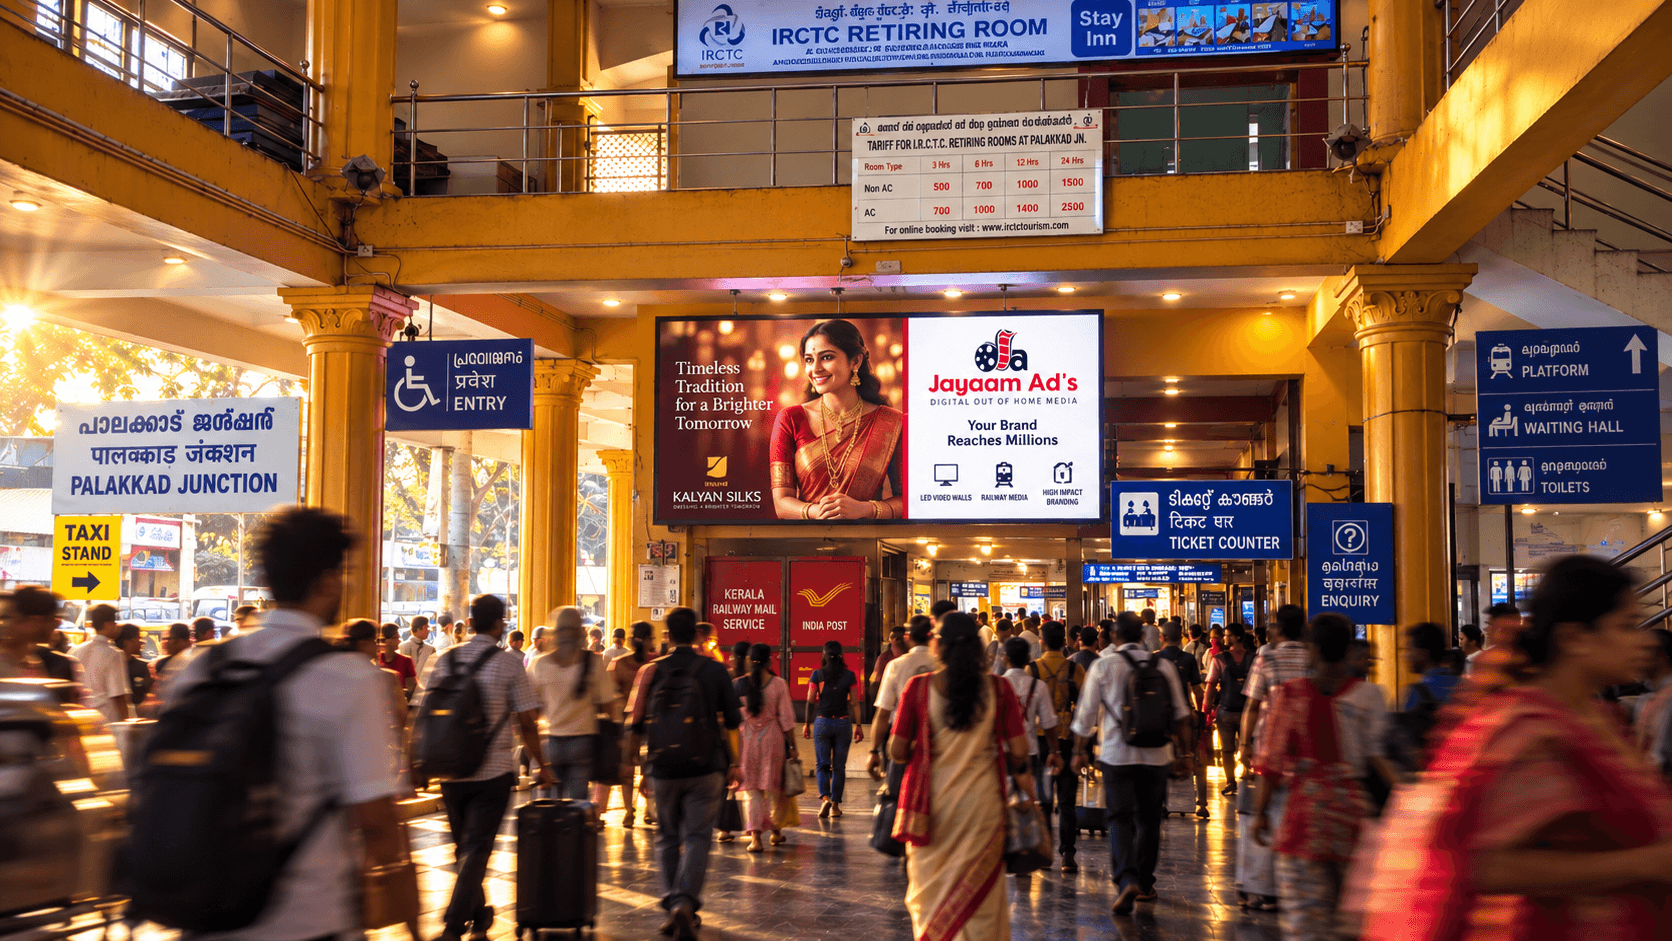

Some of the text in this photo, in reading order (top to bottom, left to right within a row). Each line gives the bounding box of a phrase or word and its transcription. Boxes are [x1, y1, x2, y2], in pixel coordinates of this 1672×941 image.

[1080, 11, 1124, 29] Stay
[773, 18, 1048, 46] IRCTC RETIRING ROOM
[1086, 31, 1117, 47] Inn
[701, 49, 743, 61] IRCTC
[867, 132, 1088, 151] TARIFF FOR I.R.C.T.C. RETIRING ROOMS AT PALAKKAD JN.
[932, 160, 951, 169] 3 Hrs
[974, 159, 994, 168] 6 Hrs
[1016, 158, 1039, 167] 12 Hrs
[1061, 156, 1084, 165] 24 Hrs
[864, 162, 903, 172] Room Type
[933, 182, 950, 191] 500
[976, 181, 993, 190] 700
[1017, 179, 1039, 189] 1000
[1062, 177, 1084, 187] 1500
[864, 184, 893, 193] Non AC
[933, 206, 950, 215] 700
[973, 205, 995, 214] 1000
[1016, 203, 1039, 213] 1400
[1061, 202, 1084, 211] 2500
[864, 208, 876, 217] AC
[884, 226, 897, 235] For
[899, 225, 924, 234] online
[925, 224, 957, 235] booking
[675, 361, 741, 375] Timeless
[1522, 364, 1589, 378] PLATFORM
[455, 370, 496, 389] प्रवेश
[928, 373, 1078, 396] Jayaam Ad's
[675, 379, 745, 393] Tradition
[455, 396, 507, 411] ENTRY
[675, 397, 774, 414] for a Brighter
[930, 398, 969, 406] DIGITAL
[1014, 397, 1042, 405] HOME
[674, 416, 752, 430] Tomorrow
[967, 419, 1037, 430] Your Brand
[1524, 421, 1624, 434] WAITING HALL
[947, 434, 1058, 446] Reaches Millions
[71, 473, 278, 496] PALAKKAD JUNCTION
[1541, 481, 1590, 493] TOILETS
[673, 491, 761, 502] KALYAN SILKS
[952, 493, 972, 501] WALLS
[981, 493, 1028, 501] RAILWAY MEDIA
[1060, 488, 1082, 496] IMPACT
[1046, 498, 1079, 506] BRANDING
[64, 524, 110, 541] TAXI
[1168, 535, 1280, 550] TICKET COUNTER
[62, 546, 112, 560] STAND
[724, 588, 765, 600] KERALA
[1321, 594, 1380, 609] ENQUIRY
[712, 603, 777, 615] RAILWAY MAIL
[723, 618, 765, 631] SERVICE
[802, 620, 847, 631] INDIA POST
